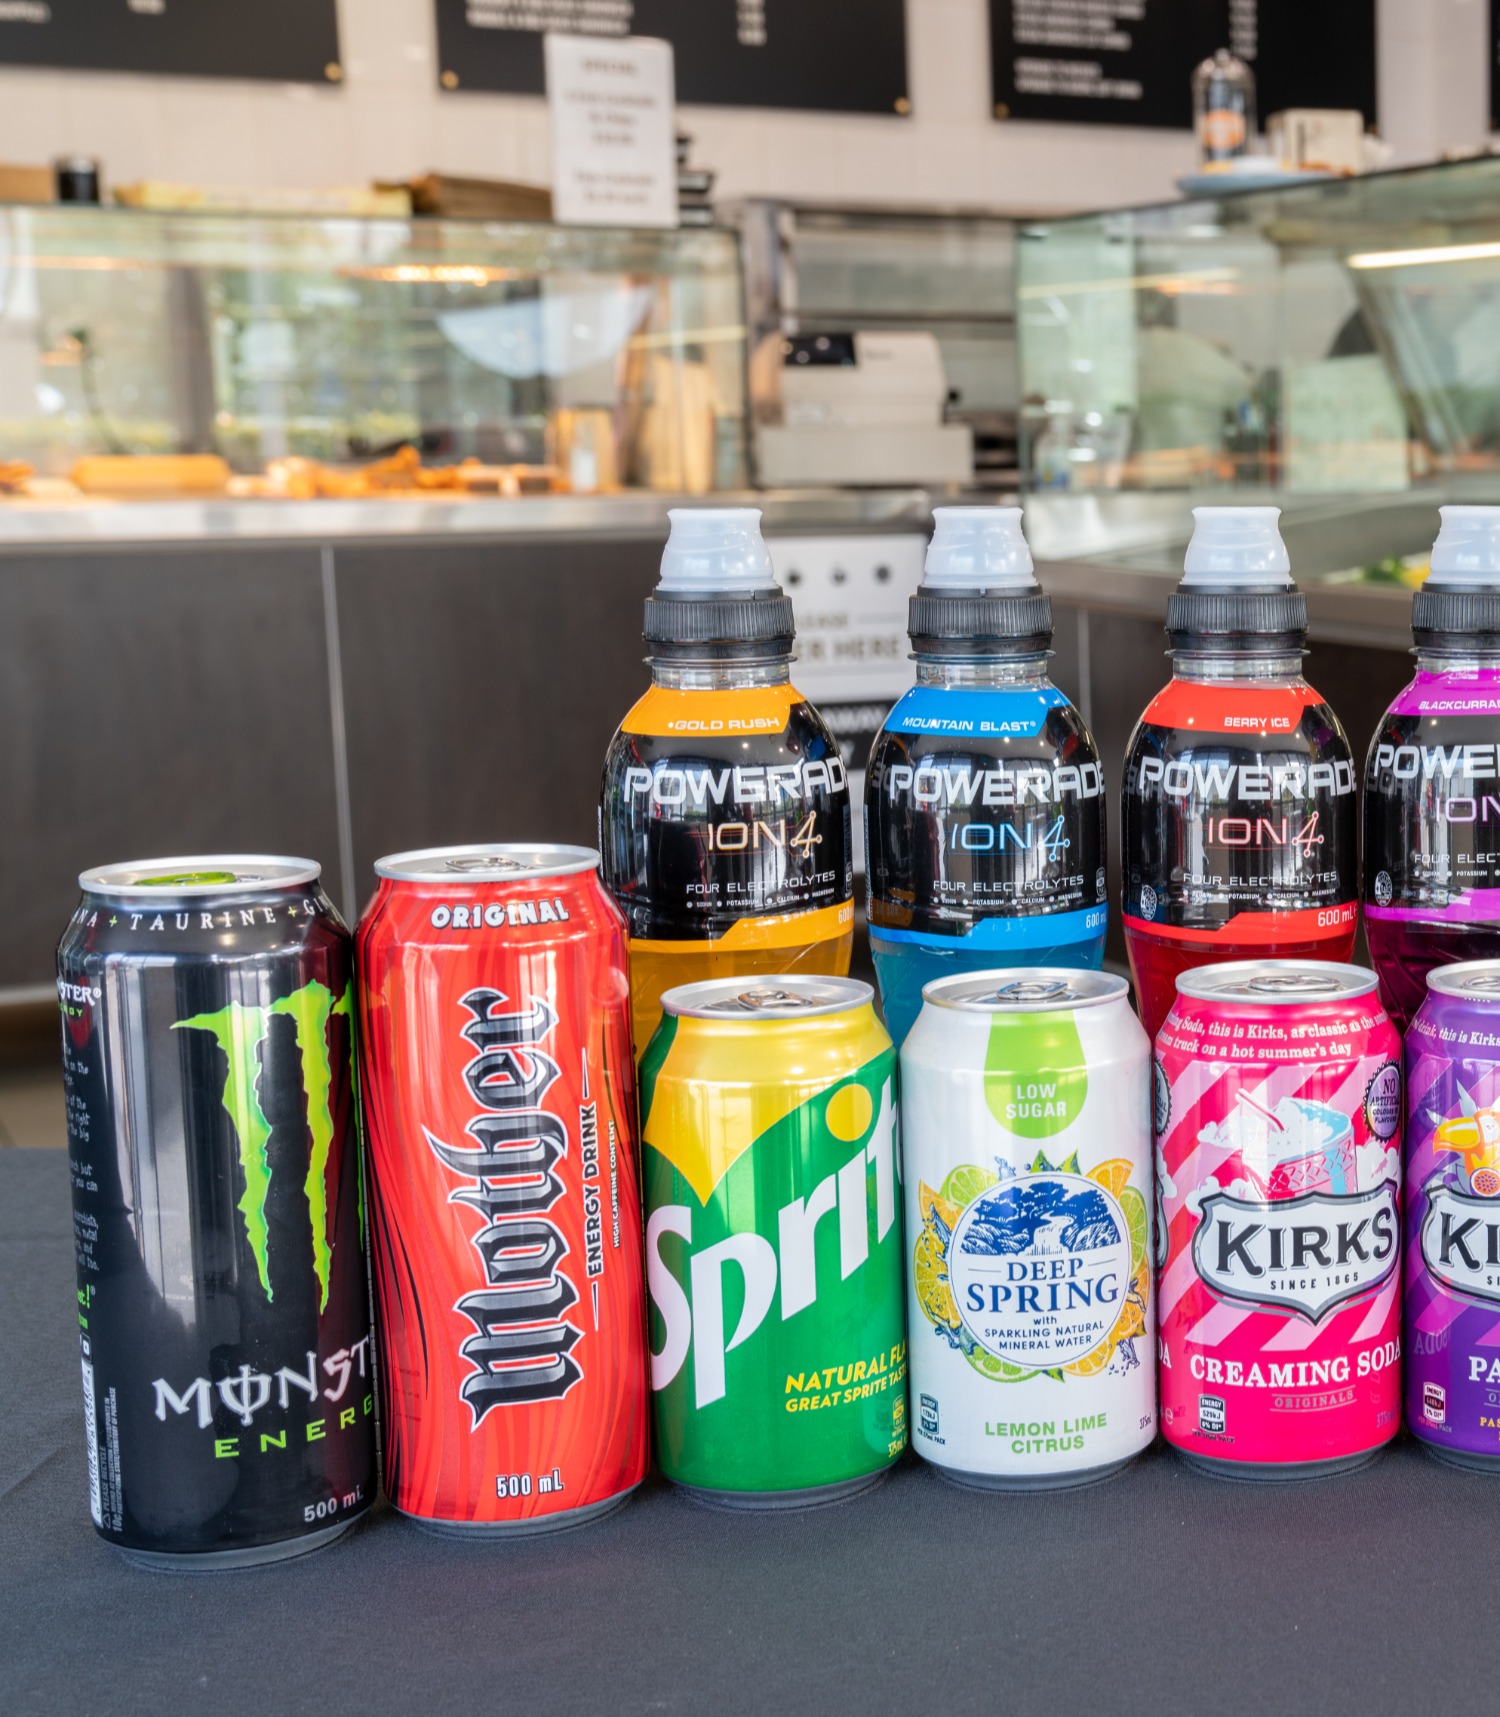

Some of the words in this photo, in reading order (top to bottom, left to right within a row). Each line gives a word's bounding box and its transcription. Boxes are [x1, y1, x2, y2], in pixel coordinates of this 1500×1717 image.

[675, 720, 723, 730] GOLD
[729, 718, 779, 729] RUSH
[903, 717, 973, 730] MOUNTAIN
[1224, 718, 1267, 727] BERRY
[1271, 718, 1290, 727] ICE
[624, 757, 849, 805] POWERAD
[1139, 755, 1357, 800] POWERADE
[1415, 854, 1450, 864] FOUR
[934, 881, 966, 891] FOUR
[973, 875, 1084, 892] ELECTROLYTES
[130, 907, 277, 931] TAURINE
[430, 898, 570, 930] ORIGINAL
[1317, 910, 1340, 927] 600
[1182, 1016, 1205, 1036] Soda,
[1209, 1022, 1230, 1037] this
[1233, 1024, 1245, 1038] is
[1247, 1024, 1288, 1041] Kirks,
[1291, 1027, 1305, 1038] as
[1308, 1021, 1348, 1037] classic
[1349, 1020, 1361, 1032] as
[1361, 1016, 1375, 1029] the
[1439, 1027, 1456, 1041] this
[1458, 1030, 1467, 1043] is
[1173, 1037, 1199, 1053] truck
[1202, 1044, 1216, 1056] on
[1220, 1046, 1227, 1056] a
[1231, 1043, 1255, 1057] hot
[1330, 1041, 1351, 1056] day
[1016, 1083, 1057, 1100] LOW
[1005, 1102, 1067, 1120] SUGAR
[579, 1101, 600, 1179] DRINK
[607, 1120, 618, 1169] CONTENT
[610, 1170, 619, 1220] CAFFEINE
[582, 1183, 604, 1277] ENERGY
[612, 1226, 621, 1249] HIGH
[646, 1074, 898, 1410] Sprit
[1216, 1206, 1394, 1277] KIRKS
[1007, 1258, 1084, 1282] DEEP
[967, 1273, 1119, 1313] SPRING
[984, 1328, 1051, 1338] SPARKLING
[1056, 1320, 1104, 1335] NATURAL
[1033, 1316, 1057, 1325] with
[999, 1339, 1050, 1350] MINERAL
[1055, 1335, 1092, 1348] WATER
[785, 1352, 887, 1393] NATURAL
[1190, 1354, 1351, 1388] CREAMING
[1357, 1336, 1401, 1377] SODA
[151, 1335, 371, 1430] MONST
[785, 1391, 841, 1413] GREAT
[843, 1375, 887, 1403] SPRITE
[215, 1392, 373, 1458] ENERG
[985, 1421, 1055, 1437] LEMON
[1063, 1413, 1107, 1434] LIME
[1011, 1435, 1085, 1454] CITRUS
[495, 1474, 531, 1498] 500
[538, 1468, 565, 1494] mL
[304, 1497, 338, 1523] 500
[342, 1486, 365, 1509] mL
